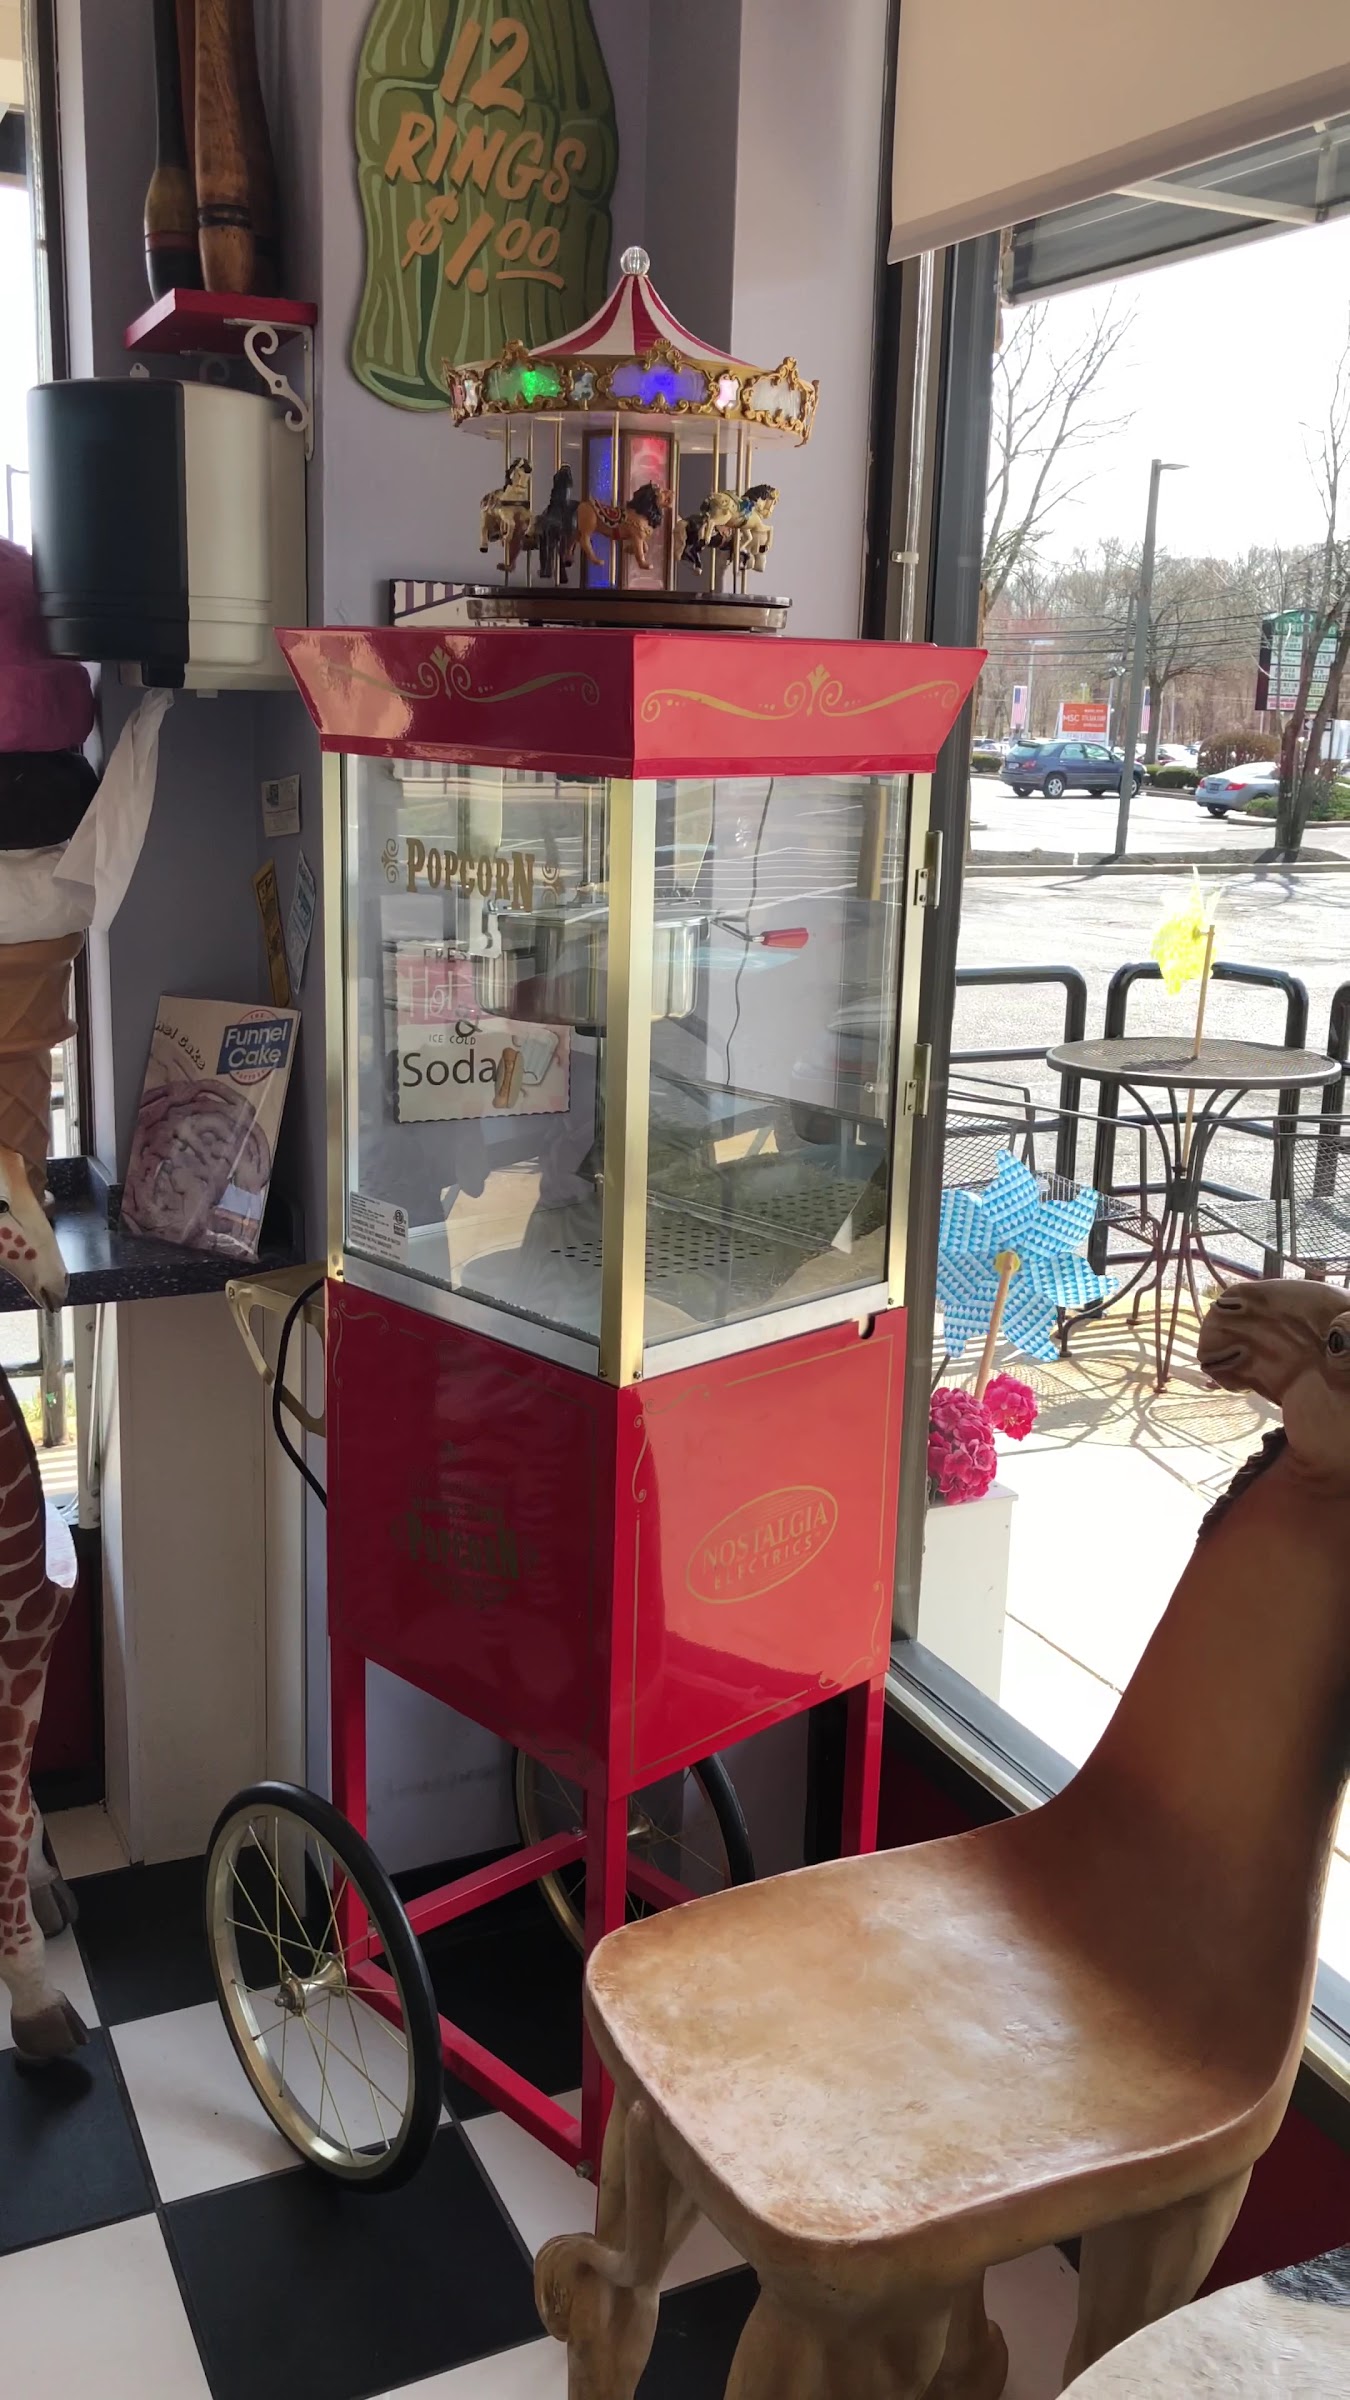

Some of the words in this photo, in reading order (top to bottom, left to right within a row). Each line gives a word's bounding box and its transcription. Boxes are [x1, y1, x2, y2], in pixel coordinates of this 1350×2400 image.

[440, 18, 530, 116] 12
[384, 111, 587, 204] RINGS
[401, 190, 562, 293] $1.00
[406, 837, 535, 912] POPCORN
[423, 948, 469, 964] FRES
[155, 1021, 178, 1040] nel
[178, 1036, 205, 1070] Cake
[225, 1022, 288, 1048] Funnel
[228, 1045, 281, 1068] Cake
[428, 1034, 444, 1044] ICE
[449, 1034, 477, 1046] COLD
[402, 1048, 497, 1087] Soda
[703, 1501, 828, 1575] NOSTALGIA
[714, 1534, 813, 1590] ELECTRICS
